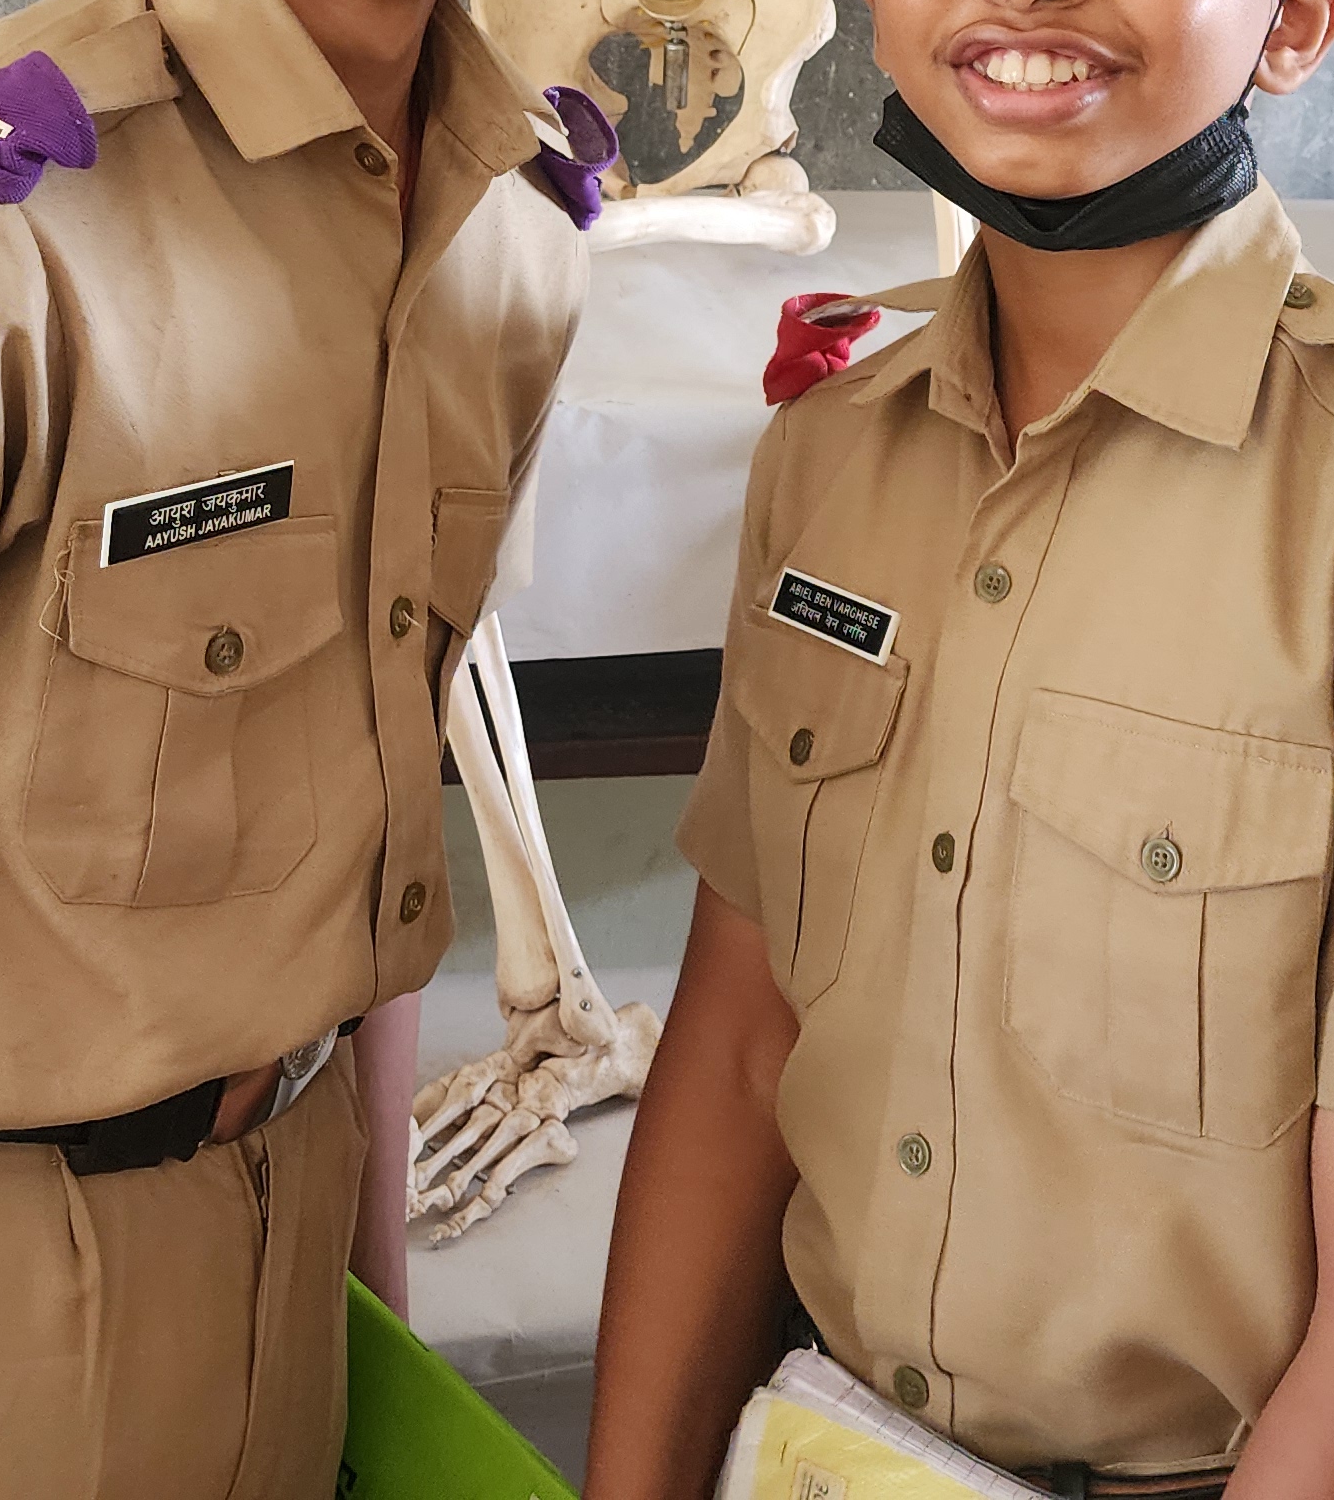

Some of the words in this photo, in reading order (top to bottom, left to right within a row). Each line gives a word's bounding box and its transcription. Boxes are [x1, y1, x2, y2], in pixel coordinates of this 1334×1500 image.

[144, 523, 196, 550] AAYUSH
[197, 503, 272, 535] JAYAKUMAR
[148, 499, 197, 528] आयुश
[201, 482, 267, 513] जयकुमार
[788, 582, 813, 602] ABIEL
[813, 591, 833, 609] BEN
[832, 599, 881, 630] VARGHESE
